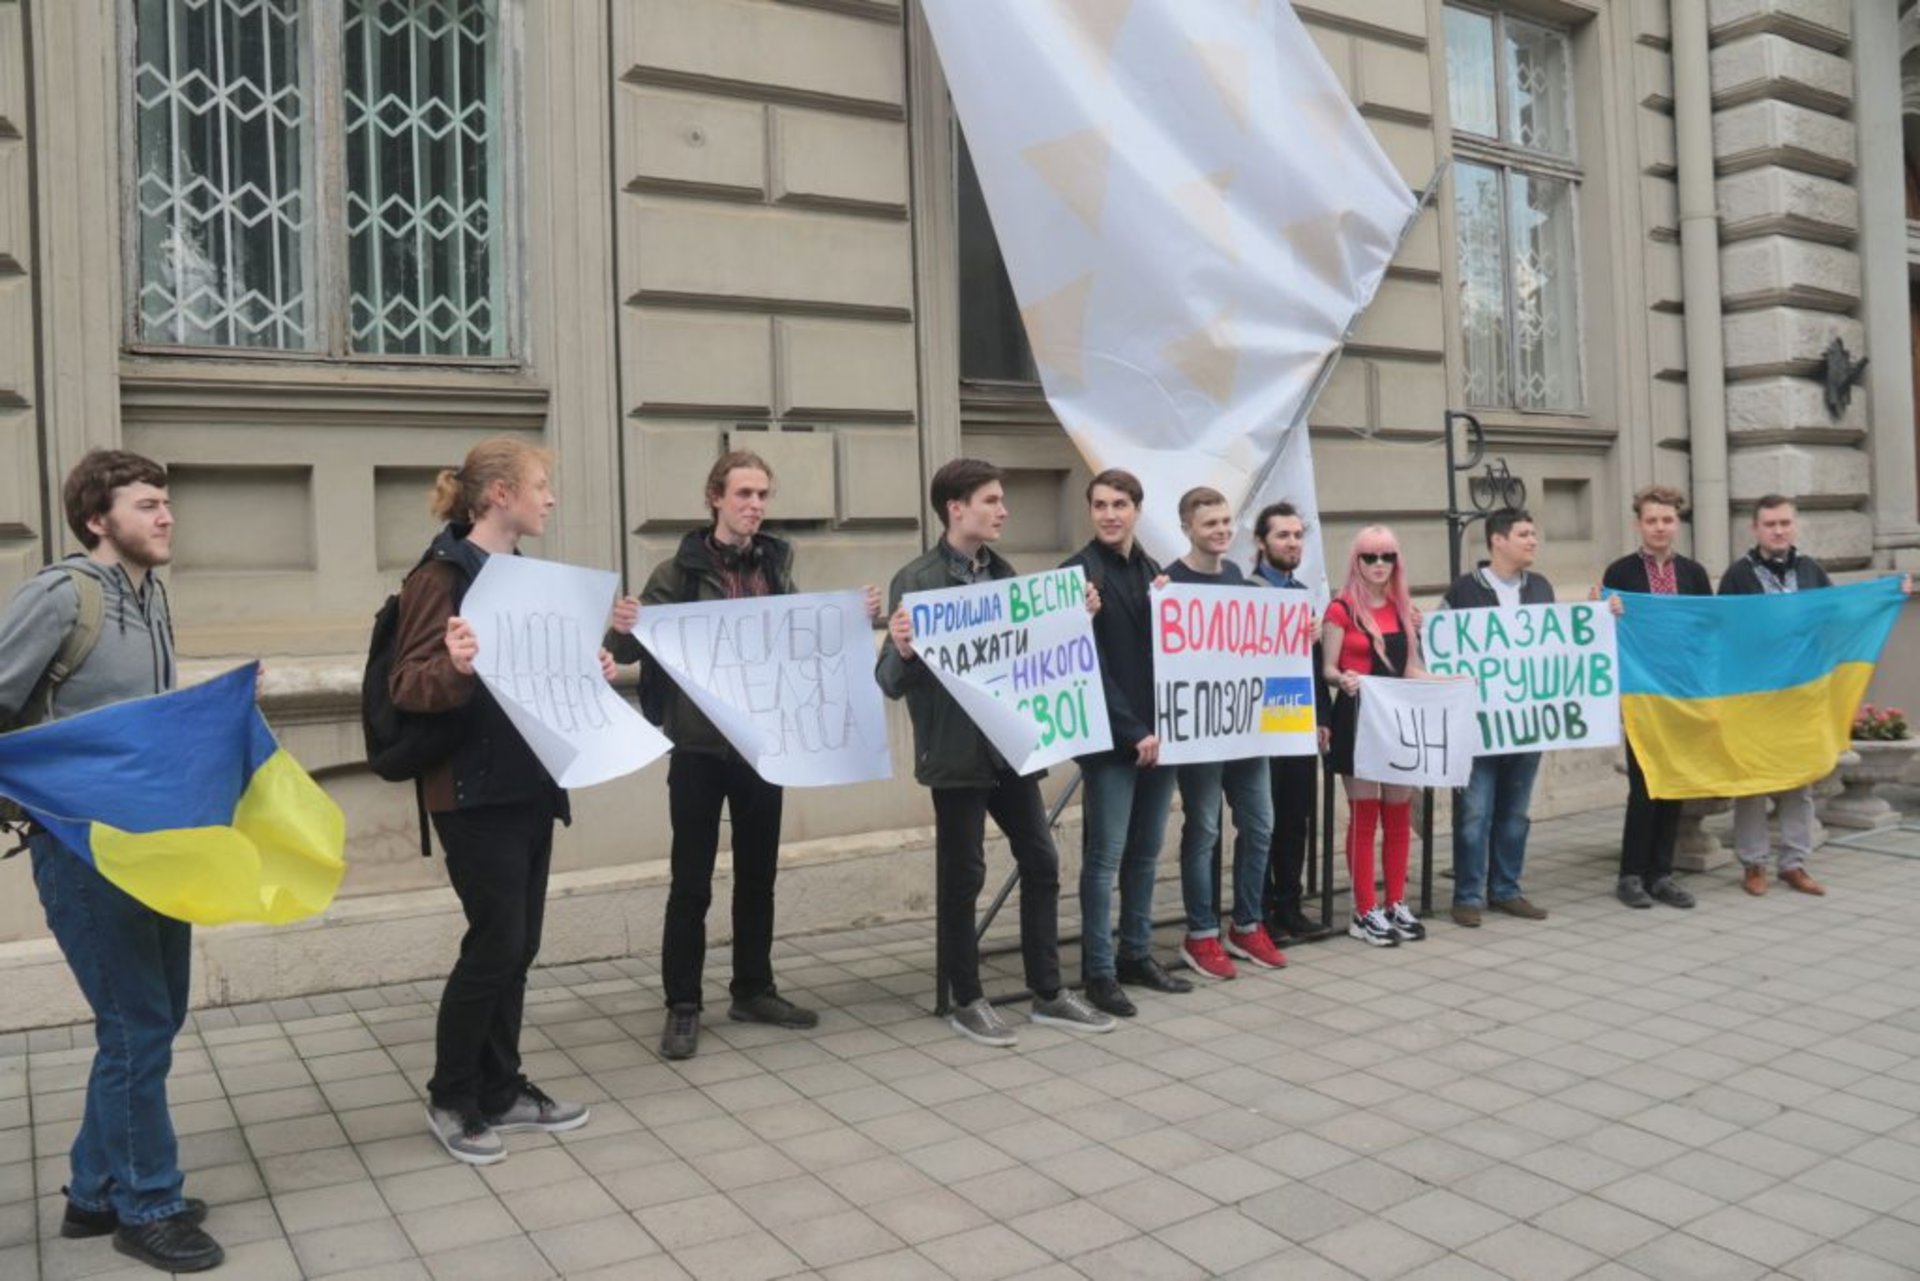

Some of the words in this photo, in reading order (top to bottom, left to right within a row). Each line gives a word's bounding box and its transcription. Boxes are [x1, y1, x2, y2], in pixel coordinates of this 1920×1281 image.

[1009, 569, 1083, 623] ВЕСНА
[1160, 597, 1311, 657] ВОЛОДЬКА
[651, 604, 845, 676] СПАСИБО
[1429, 605, 1595, 658] СКАЗАВ
[1012, 635, 1094, 692] НІКОГО
[1017, 680, 1088, 748] ВОЇ
[1158, 681, 1189, 743] НЕ
[1195, 677, 1263, 739] ПОЗОР
[1389, 707, 1447, 776] УН
